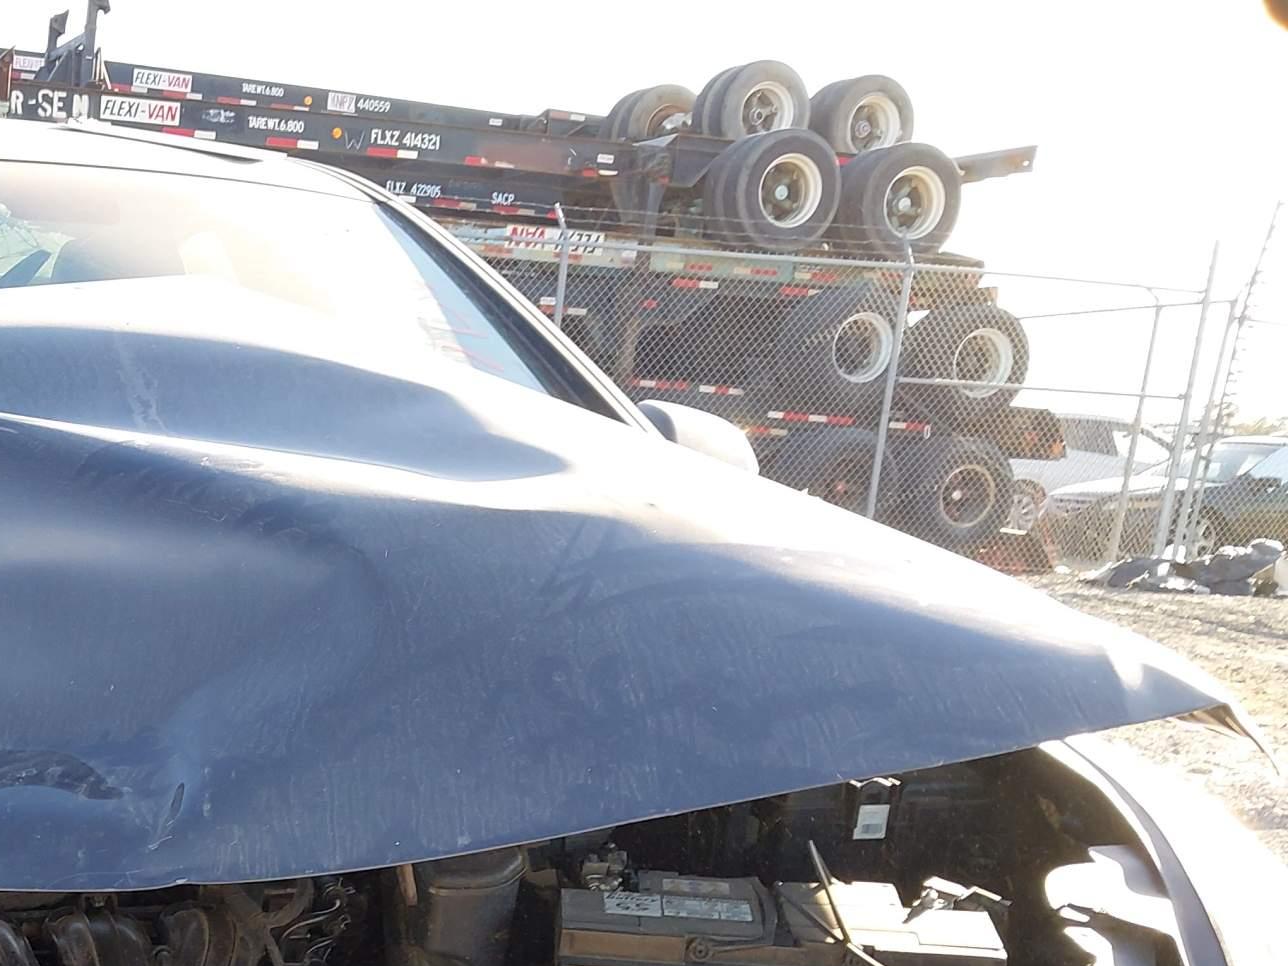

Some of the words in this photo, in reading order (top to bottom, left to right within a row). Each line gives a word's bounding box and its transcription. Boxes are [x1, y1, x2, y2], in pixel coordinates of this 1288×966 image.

[135, 70, 191, 89] FLEXI-VAN
[103, 98, 178, 122] FLEXI-VAN
[357, 98, 391, 113] 440559
[370, 129, 399, 146] FLXZ
[402, 133, 441, 150] 414321
